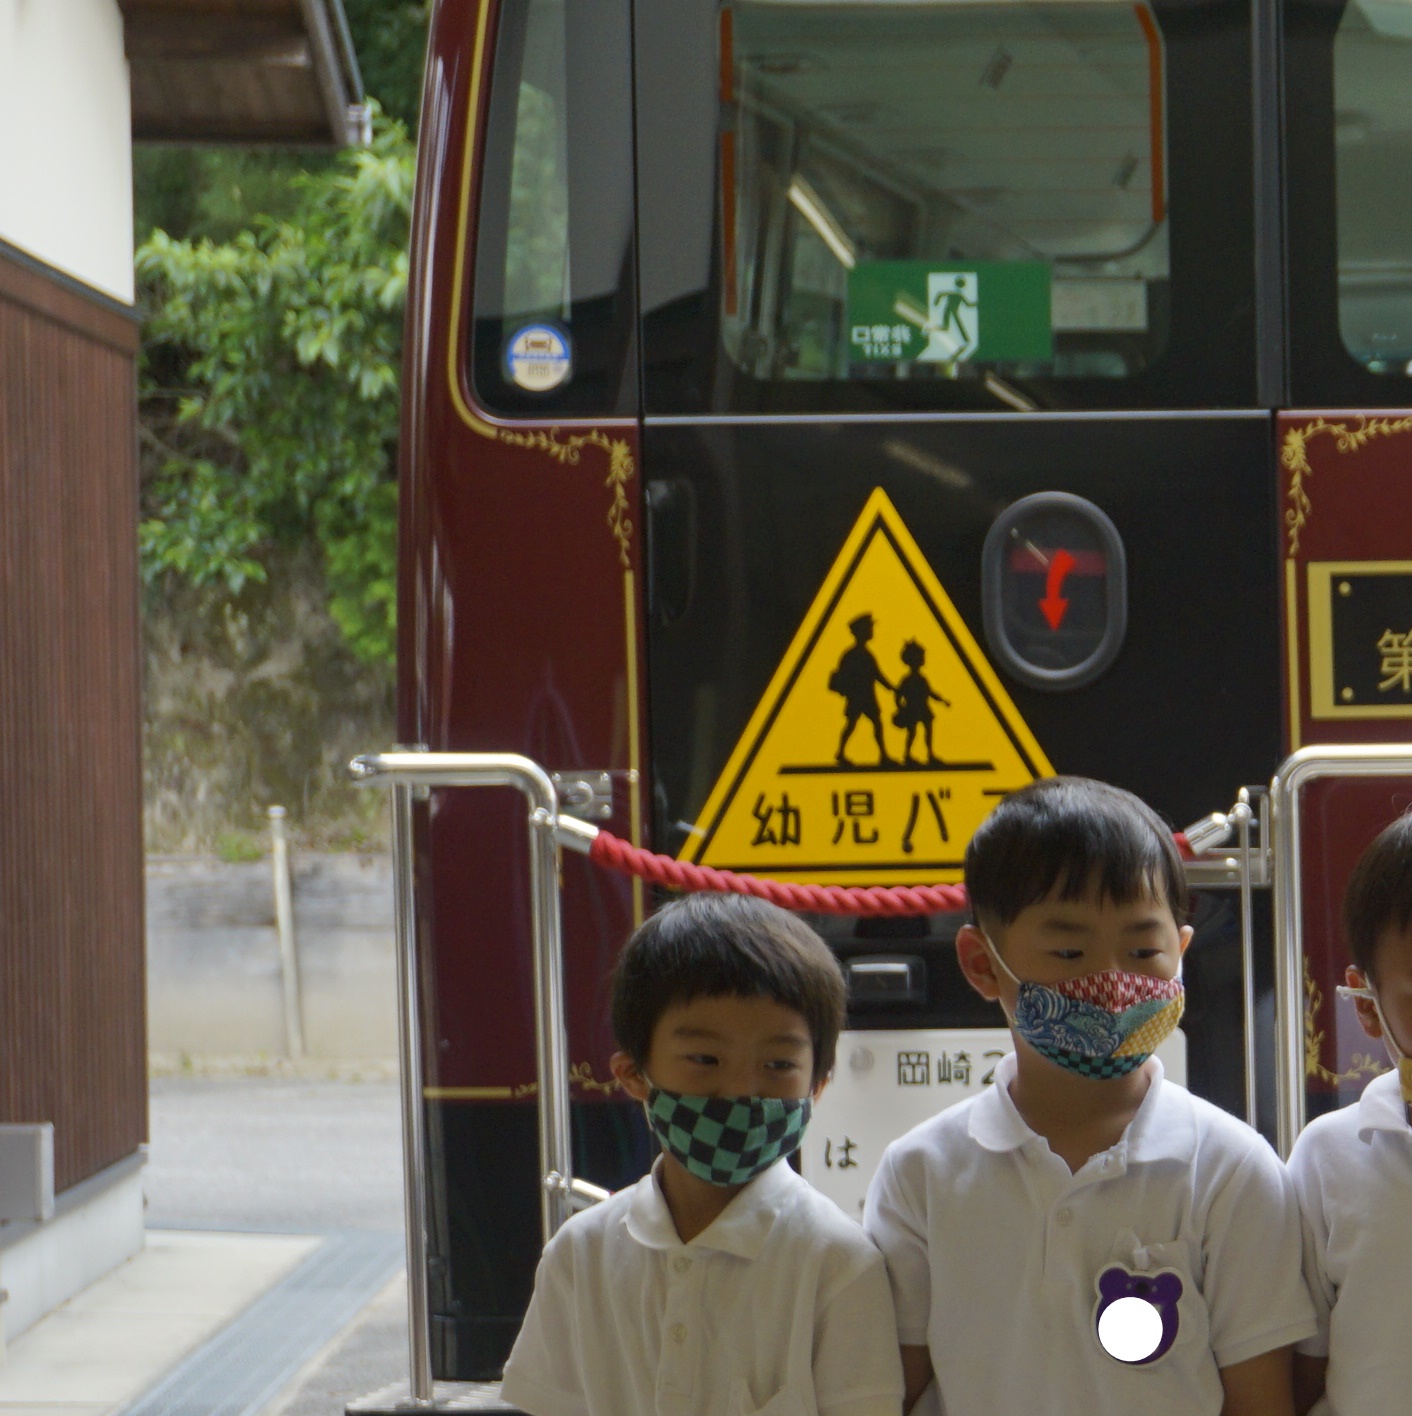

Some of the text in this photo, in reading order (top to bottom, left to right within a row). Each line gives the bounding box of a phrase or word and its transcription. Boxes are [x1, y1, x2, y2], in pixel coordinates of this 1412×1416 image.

[751, 788, 1010, 848] 幼児バ
[825, 1135, 858, 1169] は
